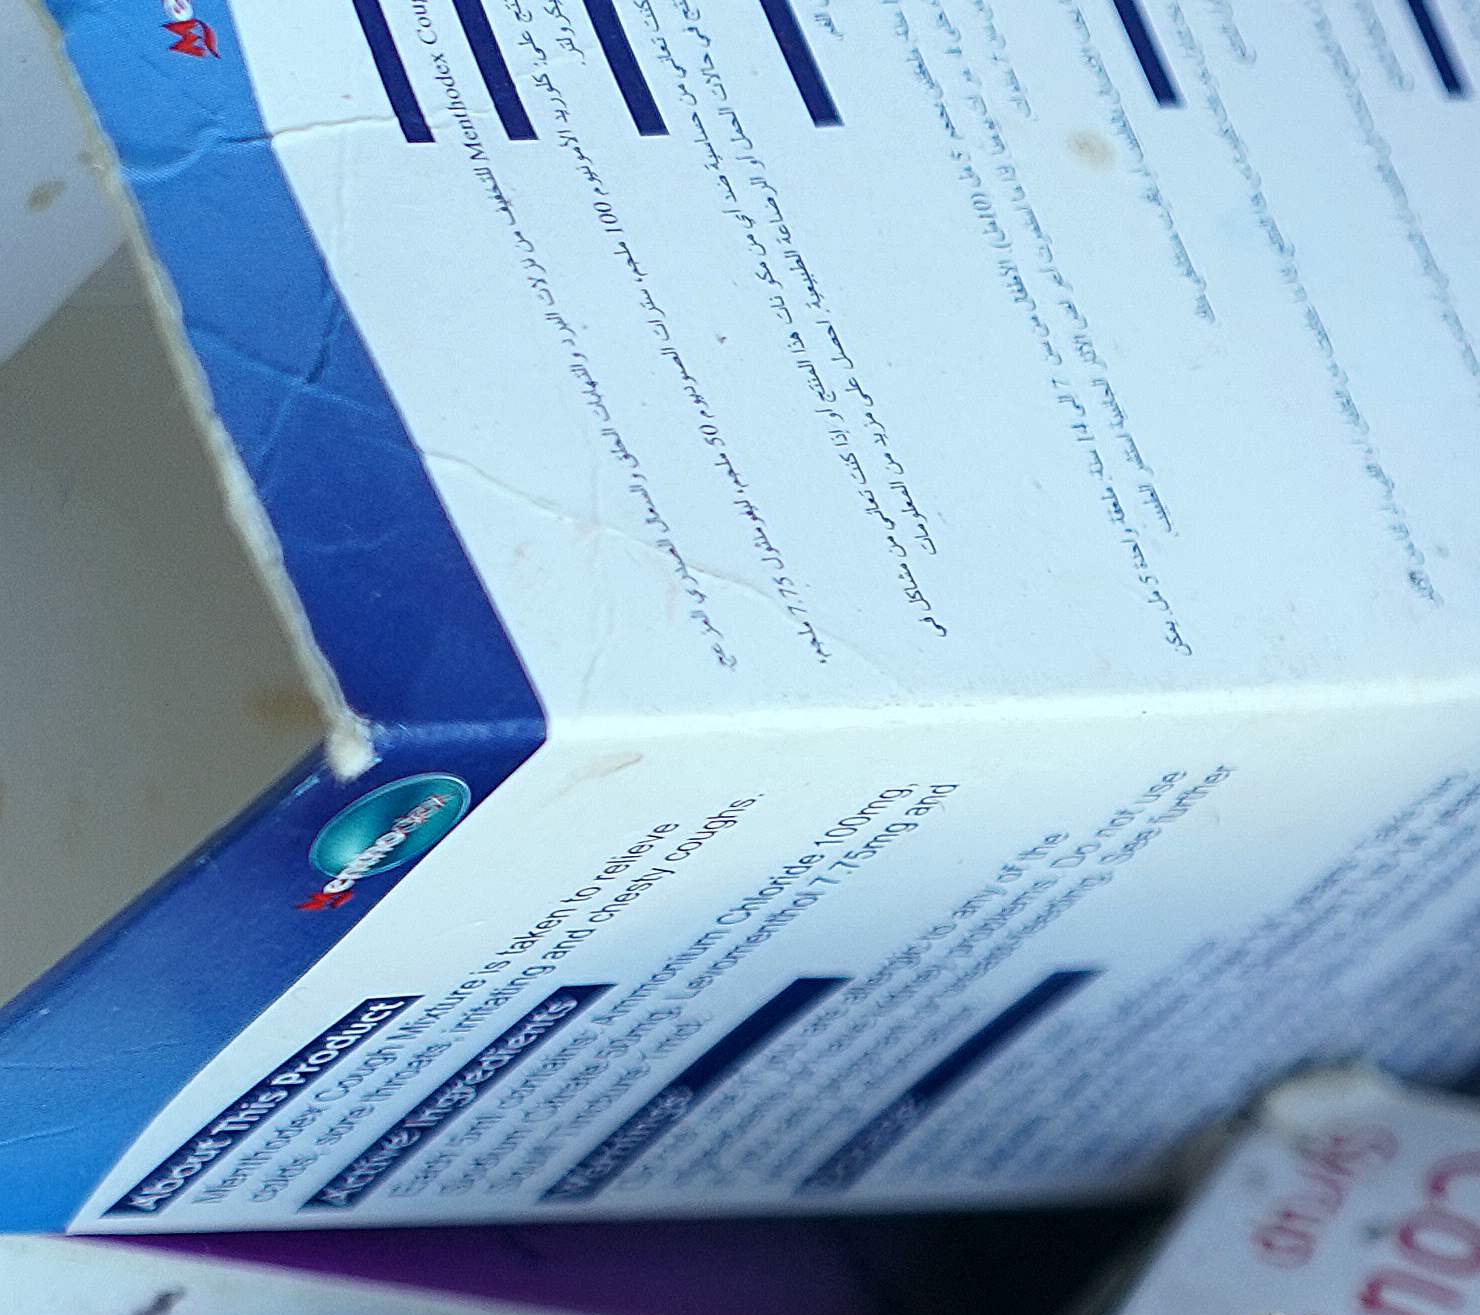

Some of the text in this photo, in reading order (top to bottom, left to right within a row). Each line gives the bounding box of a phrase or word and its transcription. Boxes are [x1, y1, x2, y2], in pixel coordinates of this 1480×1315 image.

[432, 53, 488, 161] Menthodex
[593, 201, 624, 233] 100
[699, 423, 721, 446] 50
[596, 823, 680, 888] relieve
[664, 797, 757, 862] coughs.
[211, 1081, 289, 1148] This
[278, 986, 407, 1092] Product
